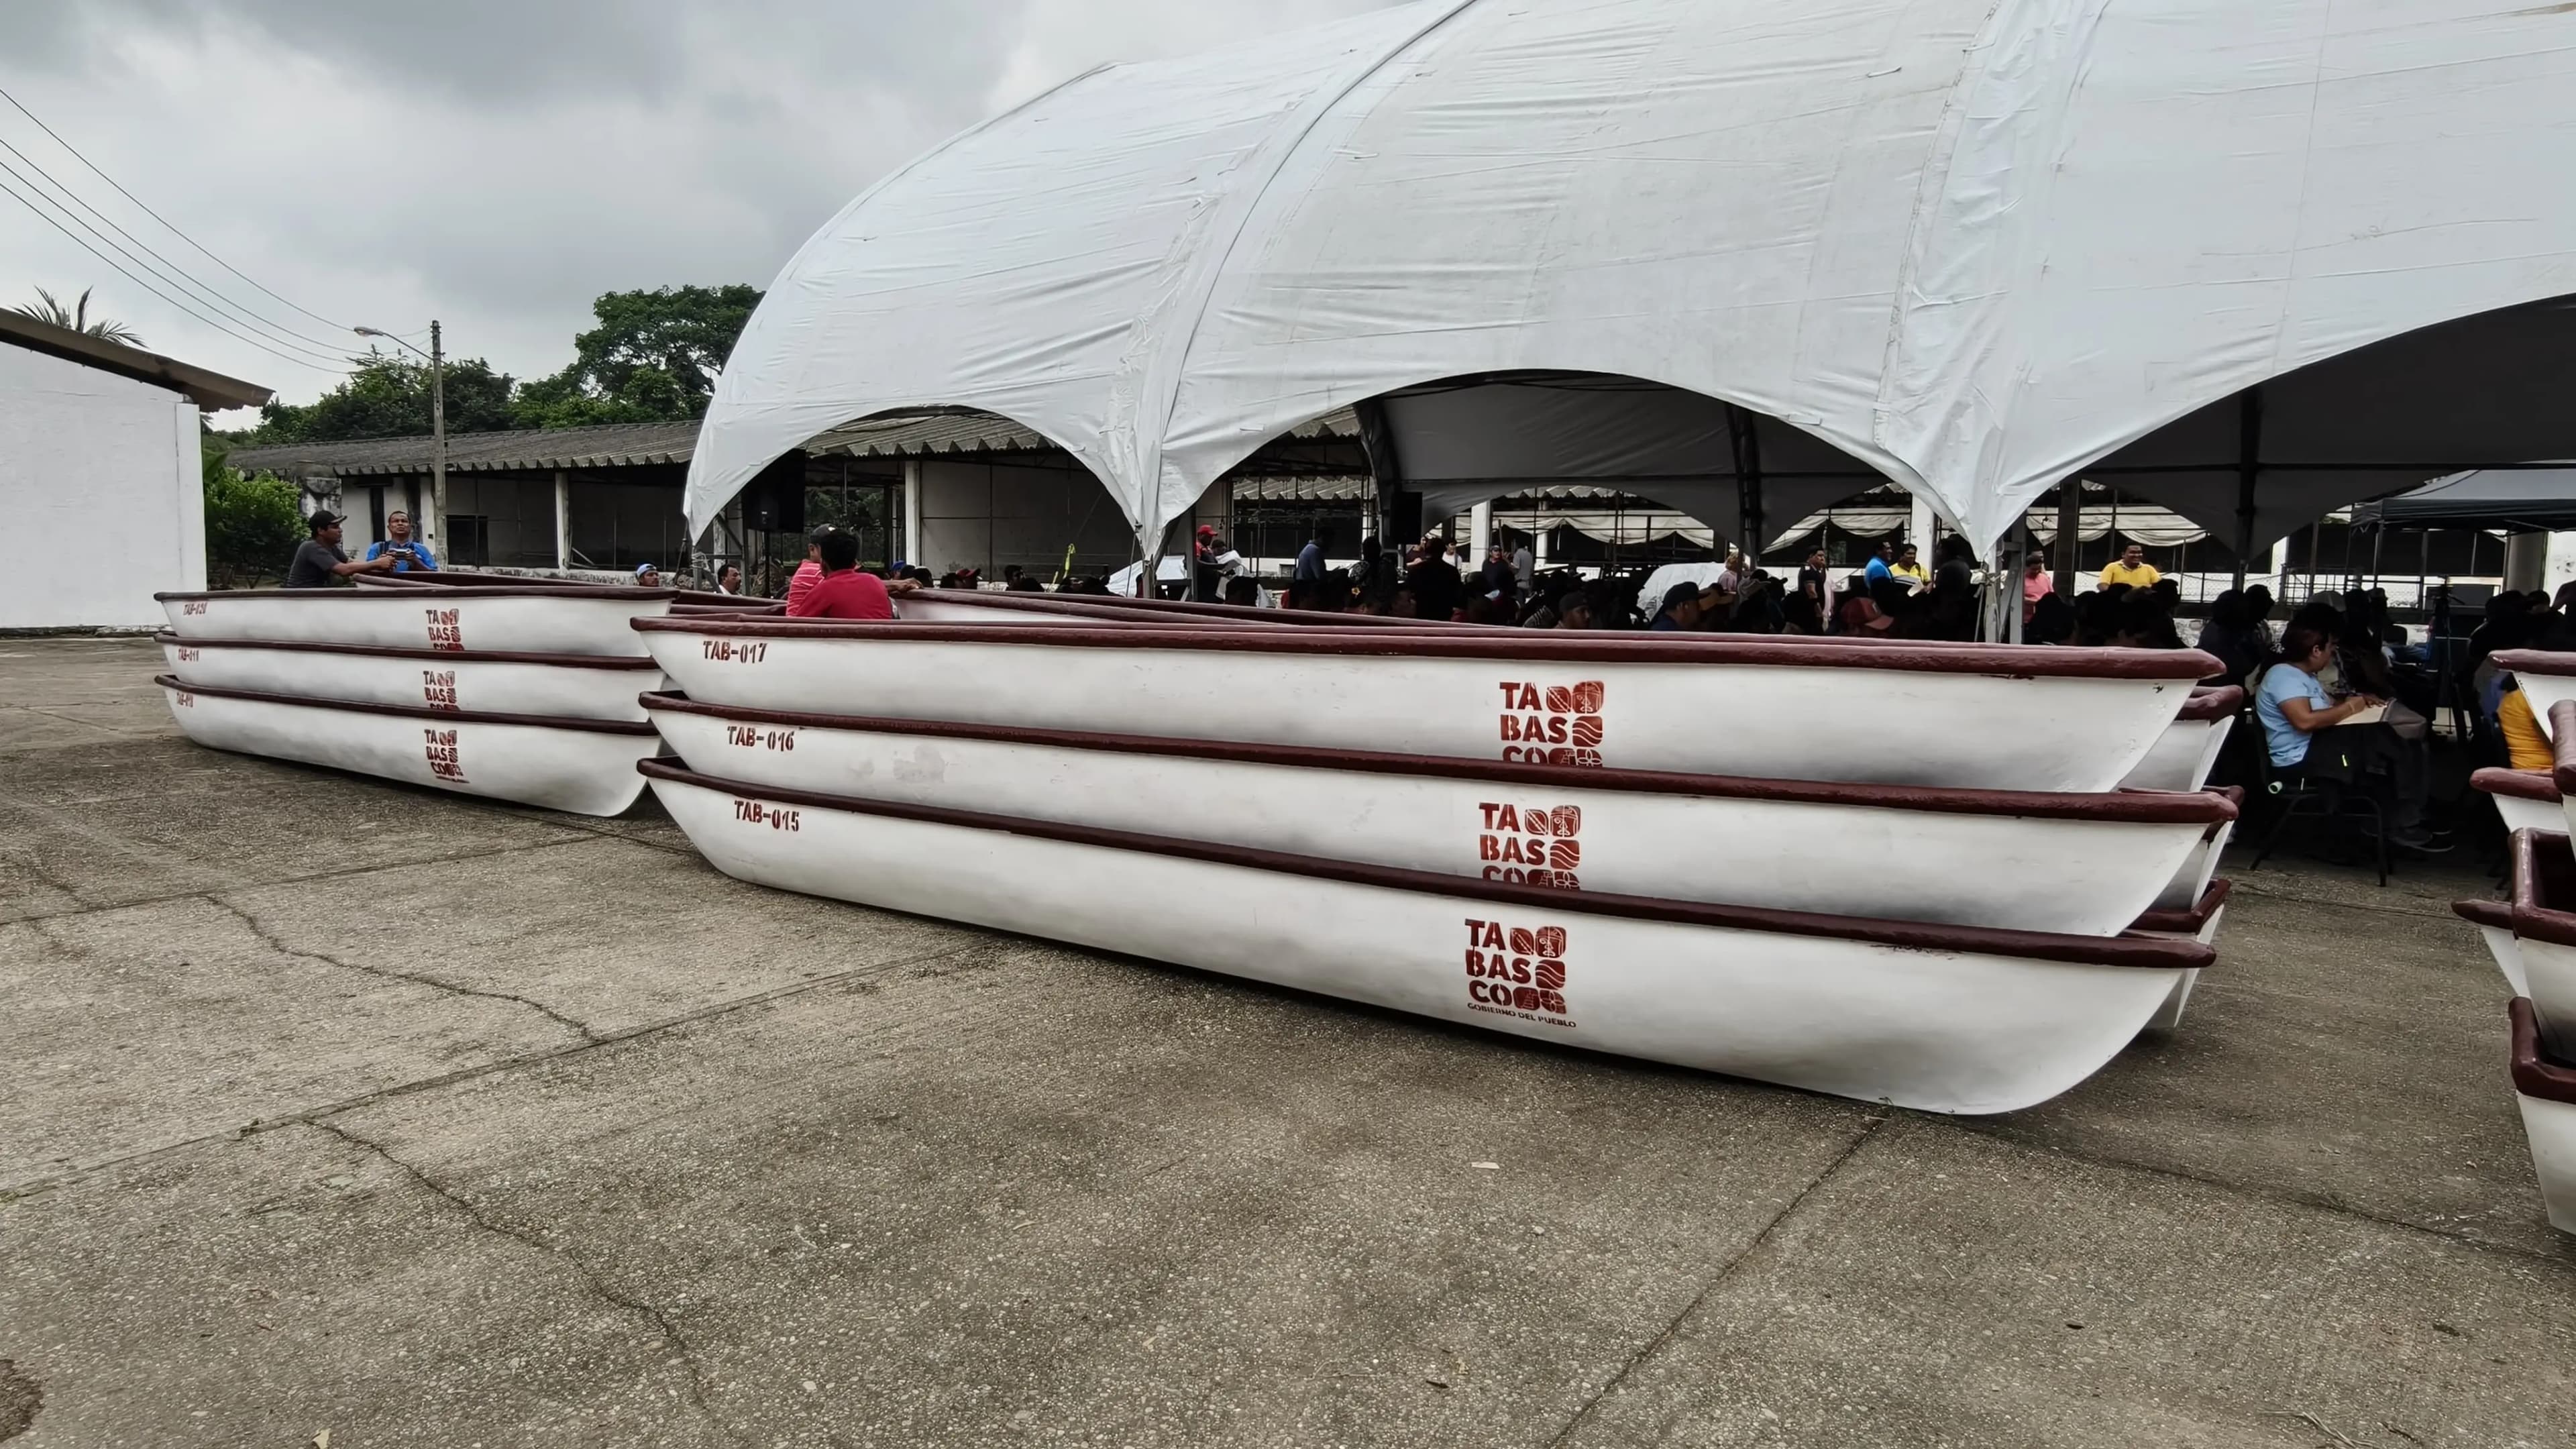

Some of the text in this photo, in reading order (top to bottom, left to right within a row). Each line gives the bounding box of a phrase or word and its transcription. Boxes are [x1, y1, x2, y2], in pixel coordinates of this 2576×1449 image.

[426, 609, 440, 625] TA
[428, 627, 450, 641] BAS
[704, 641, 767, 663] TAB-017
[423, 671, 436, 686] TA
[424, 687, 446, 702] BAS
[1499, 682, 1542, 711] TA
[424, 729, 438, 744] TA
[727, 726, 795, 752] TAB-016
[1500, 714, 1568, 744] BAS
[426, 746, 447, 761] BAS
[431, 761, 447, 775] CO
[735, 800, 800, 832] TAB-015
[1479, 802, 1521, 832] TA
[1480, 835, 1546, 865] BAS
[1465, 918, 1506, 951] TA
[1465, 949, 1531, 984] BAS
[1469, 980, 1512, 1006] CO
[1467, 1002, 1576, 1028] GOBIERNO DEL PUEBLO
